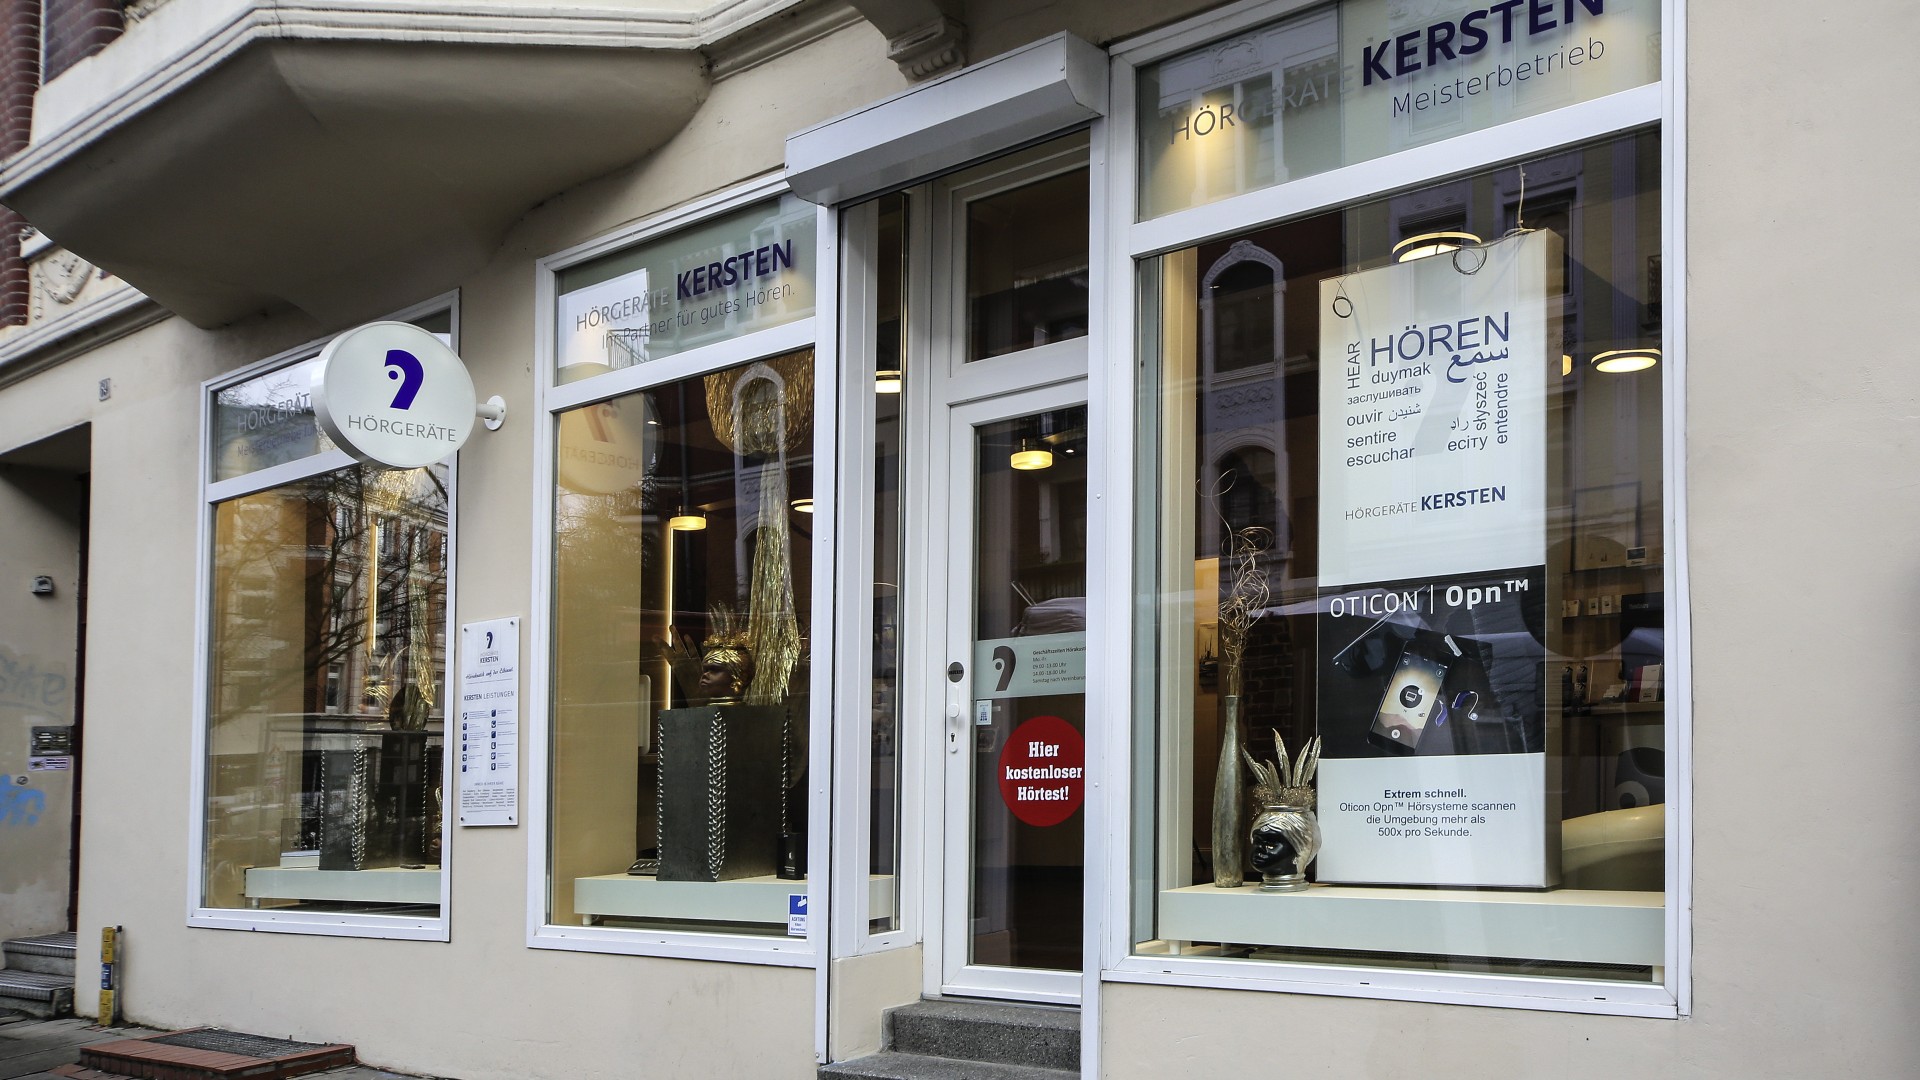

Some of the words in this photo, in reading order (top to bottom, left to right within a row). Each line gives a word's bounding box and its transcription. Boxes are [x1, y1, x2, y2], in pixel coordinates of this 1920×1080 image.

[1393, 37, 1605, 118] Meisterbetrieb
[576, 286, 669, 332] HÖRGERÄTE
[676, 239, 792, 300] KERSTEN
[623, 318, 672, 343] Partner
[676, 310, 696, 328] für
[701, 298, 740, 325] gutes
[746, 283, 796, 308] Hören.
[1371, 312, 1509, 366] HÖREN
[1347, 341, 1360, 389] HEAR
[1371, 362, 1431, 385] duymak
[1347, 385, 1421, 405] заслушивать
[237, 392, 314, 433] HÖRGERÄT
[1346, 409, 1383, 427] ouvir
[1494, 373, 1508, 444] entendre
[348, 414, 457, 442] HÖRGERÄTE
[1347, 431, 1397, 449] sentire
[1346, 446, 1415, 467] escuchar
[1345, 501, 1418, 521] HÖRGERÄTE
[1421, 485, 1506, 511] KERSTEN
[1330, 590, 1418, 618] OTICON
[480, 656, 499, 664] KERSTEN
[463, 693, 482, 701] KERSTEN
[483, 690, 515, 699] LEISTUNGEN
[1028, 741, 1060, 757] Hier
[1005, 765, 1083, 780] kostenloser
[1017, 785, 1069, 800] Hörtest!
[1384, 789, 1421, 799] Extrem
[1424, 788, 1467, 798] schnell.
[1339, 802, 1370, 811] Oticon
[1407, 802, 1468, 813] Hörsysteme
[1471, 803, 1516, 811] scannen
[1366, 815, 1381, 824] die
[1384, 815, 1438, 826] Umgebung
[1441, 815, 1468, 824] mehr
[1470, 814, 1486, 824] als
[1378, 828, 1402, 837] 500x
[1405, 829, 1421, 839] pro
[1424, 827, 1472, 837] Sekunde.
